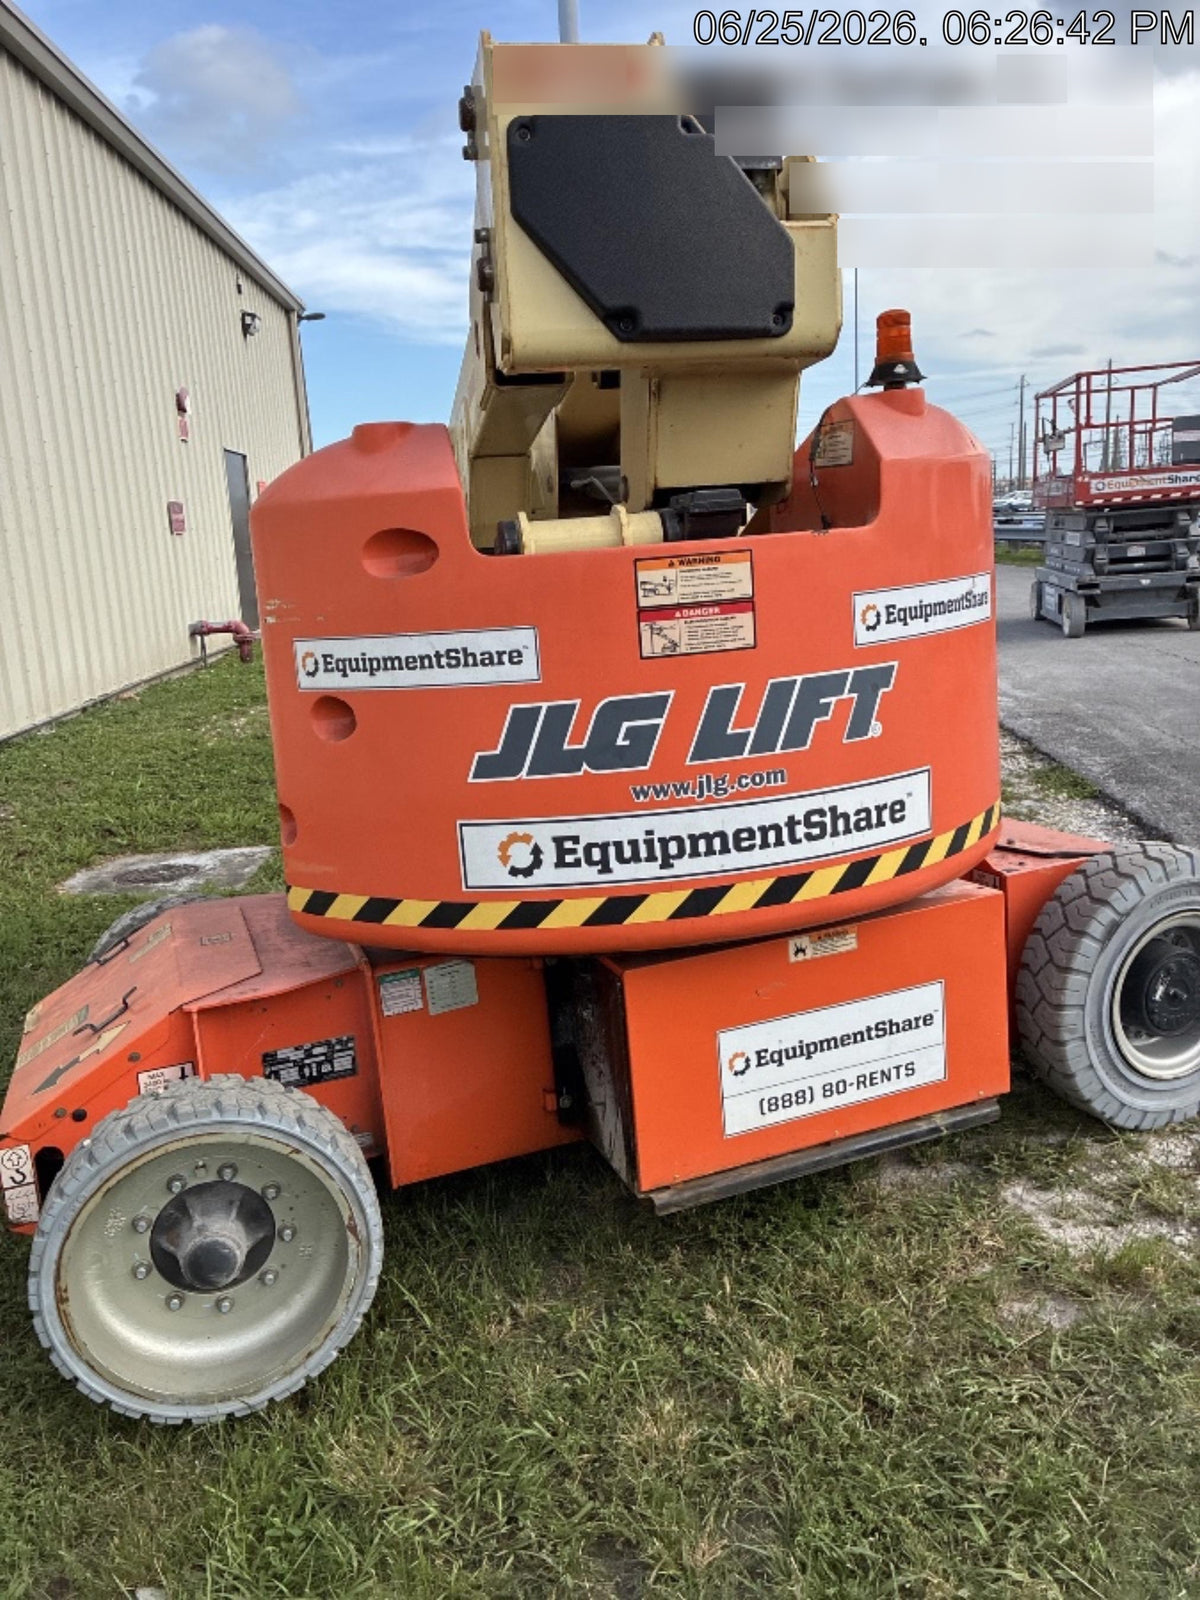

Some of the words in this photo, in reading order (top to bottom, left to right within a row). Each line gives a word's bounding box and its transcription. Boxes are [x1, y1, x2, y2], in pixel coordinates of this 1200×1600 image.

[682, 607, 720, 617] DANGER
[321, 647, 523, 677] EquipmentShare
[467, 690, 675, 783] JLG
[685, 661, 898, 765] LIFT
[631, 768, 786, 801] www.jlg.com
[551, 798, 907, 875] EquipmentShare
[755, 1012, 935, 1068] EquipmentShare
[759, 1086, 815, 1116] (888)
[822, 1061, 916, 1099] 80-RENTS
